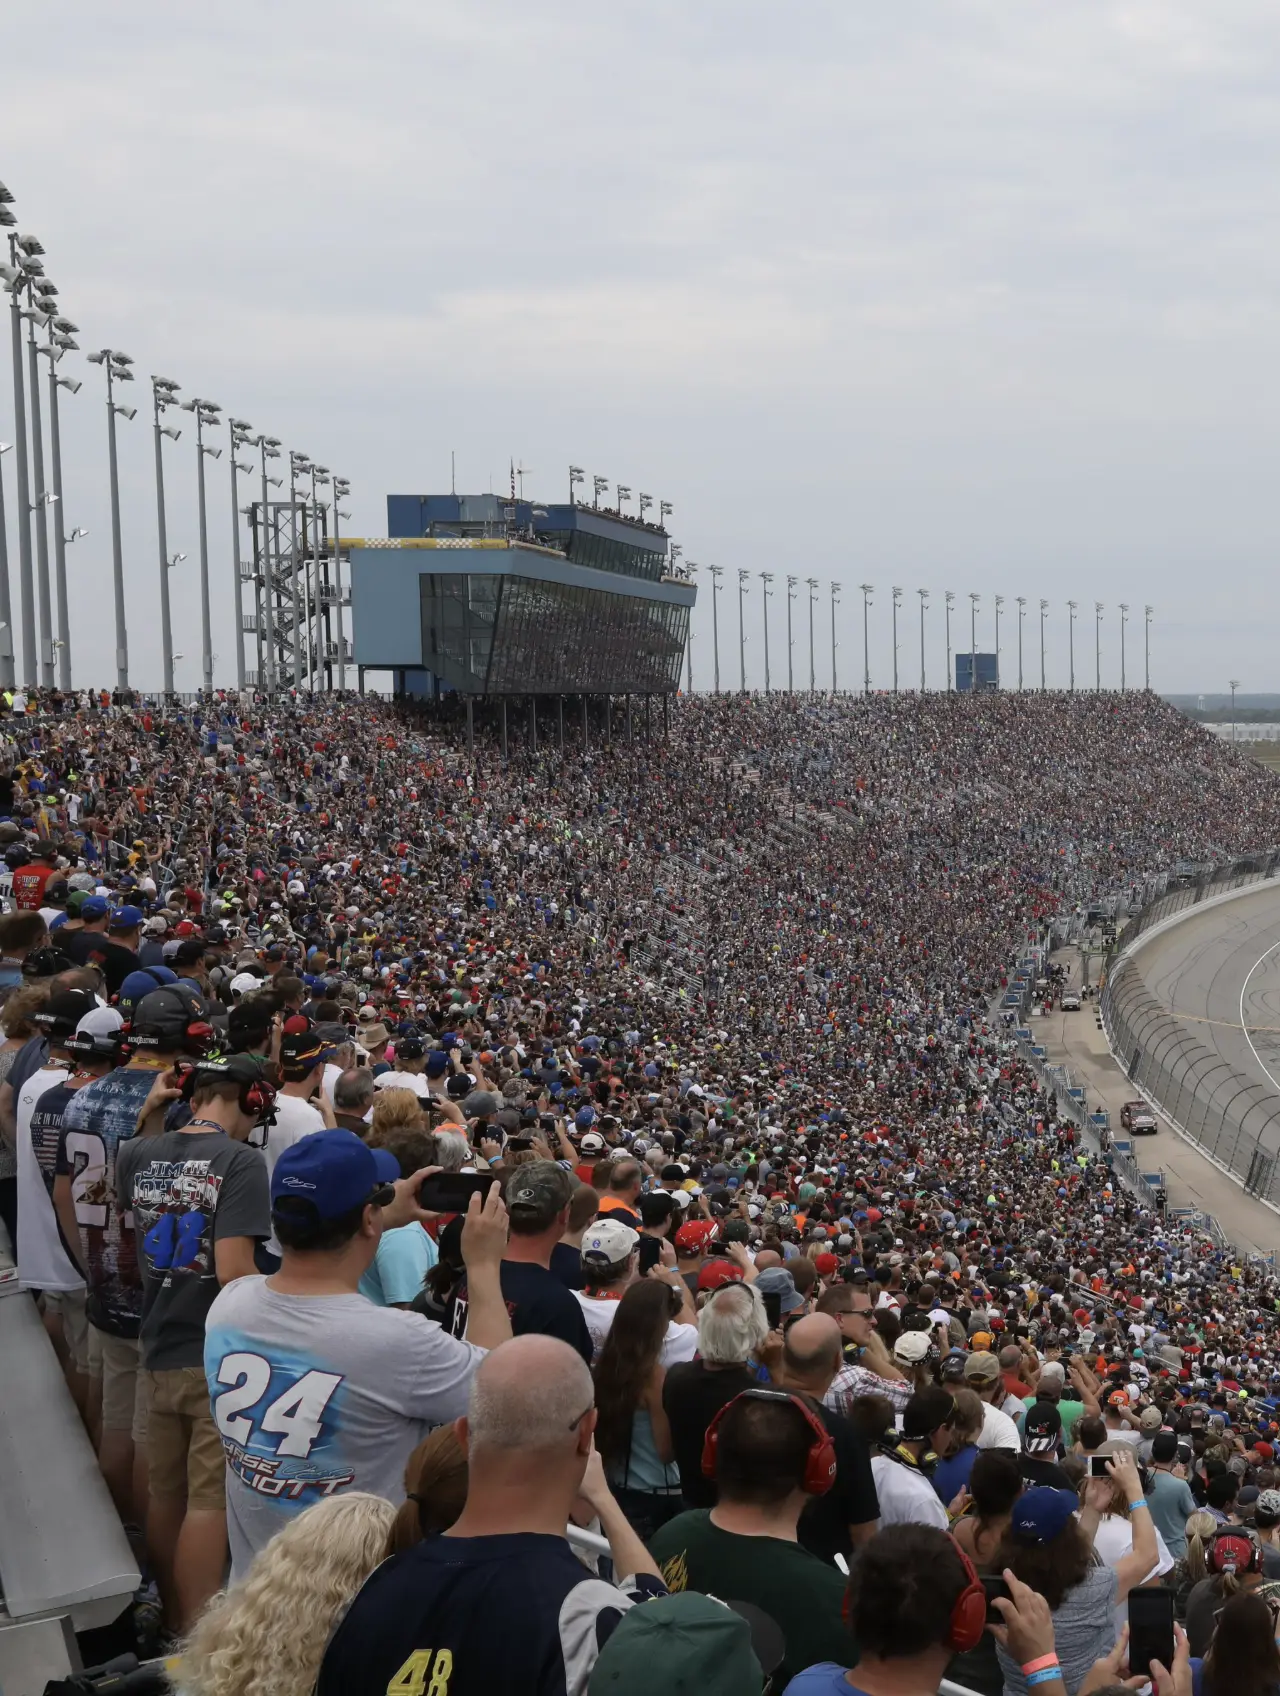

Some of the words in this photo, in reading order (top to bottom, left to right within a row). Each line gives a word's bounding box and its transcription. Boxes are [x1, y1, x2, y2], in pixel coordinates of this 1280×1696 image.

[43, 1113, 51, 1125] IN
[131, 1173, 224, 1213] JOHNSON
[143, 1211, 205, 1269] 48
[215, 1352, 345, 1459] 24
[1029, 1438, 1049, 1452] 11
[229, 1462, 355, 1499] LIOTT
[385, 1648, 453, 1696] 48
